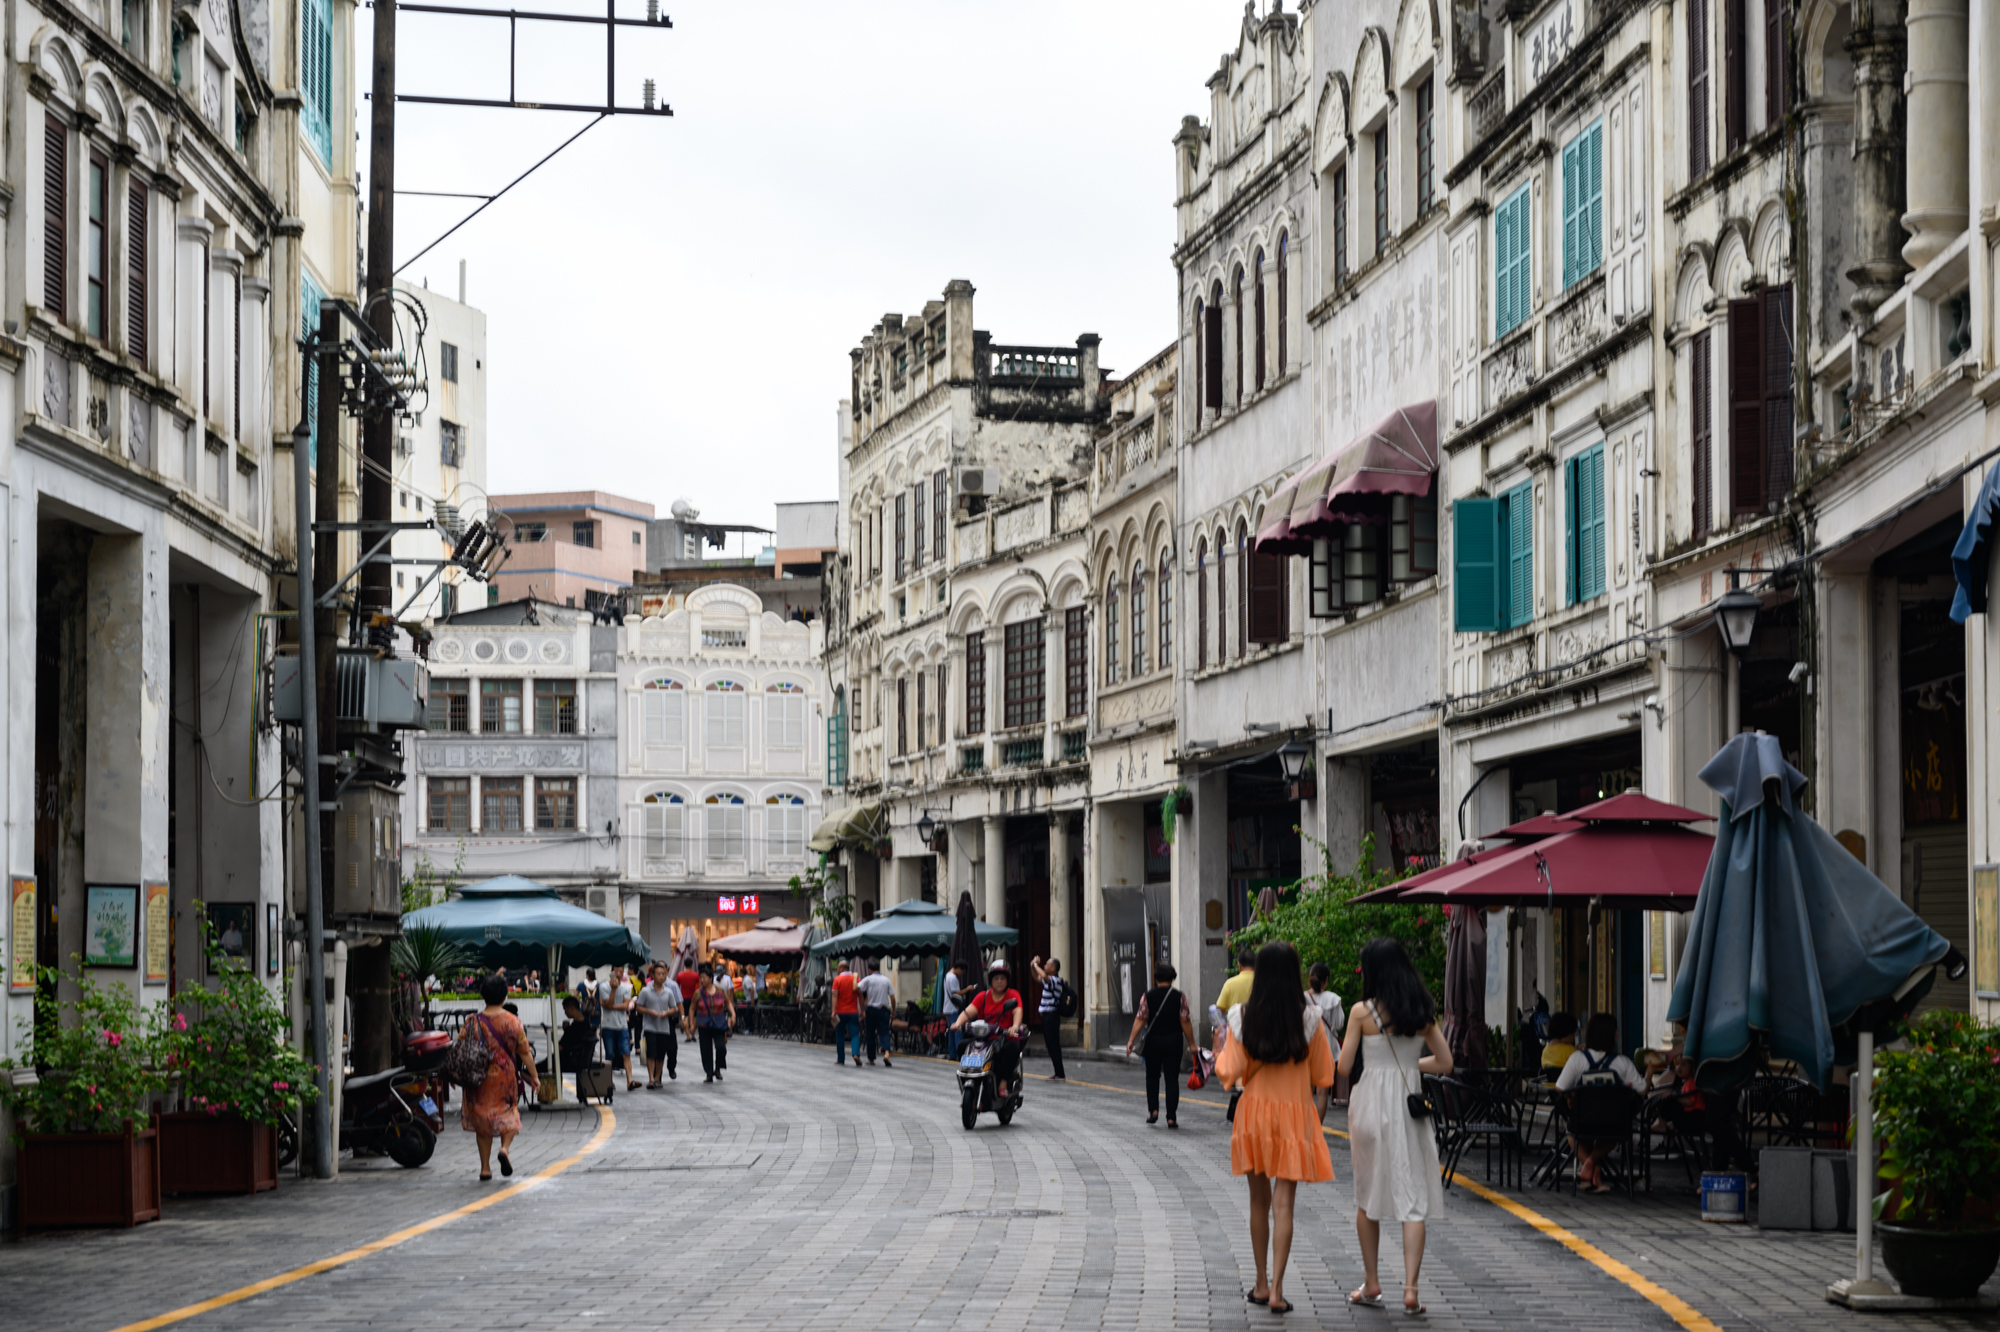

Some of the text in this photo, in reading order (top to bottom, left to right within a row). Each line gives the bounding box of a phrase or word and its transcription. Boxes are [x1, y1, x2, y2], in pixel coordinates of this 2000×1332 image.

[422, 745, 581, 767] 中国共产党万岁
[1905, 739, 1942, 791] 小店
